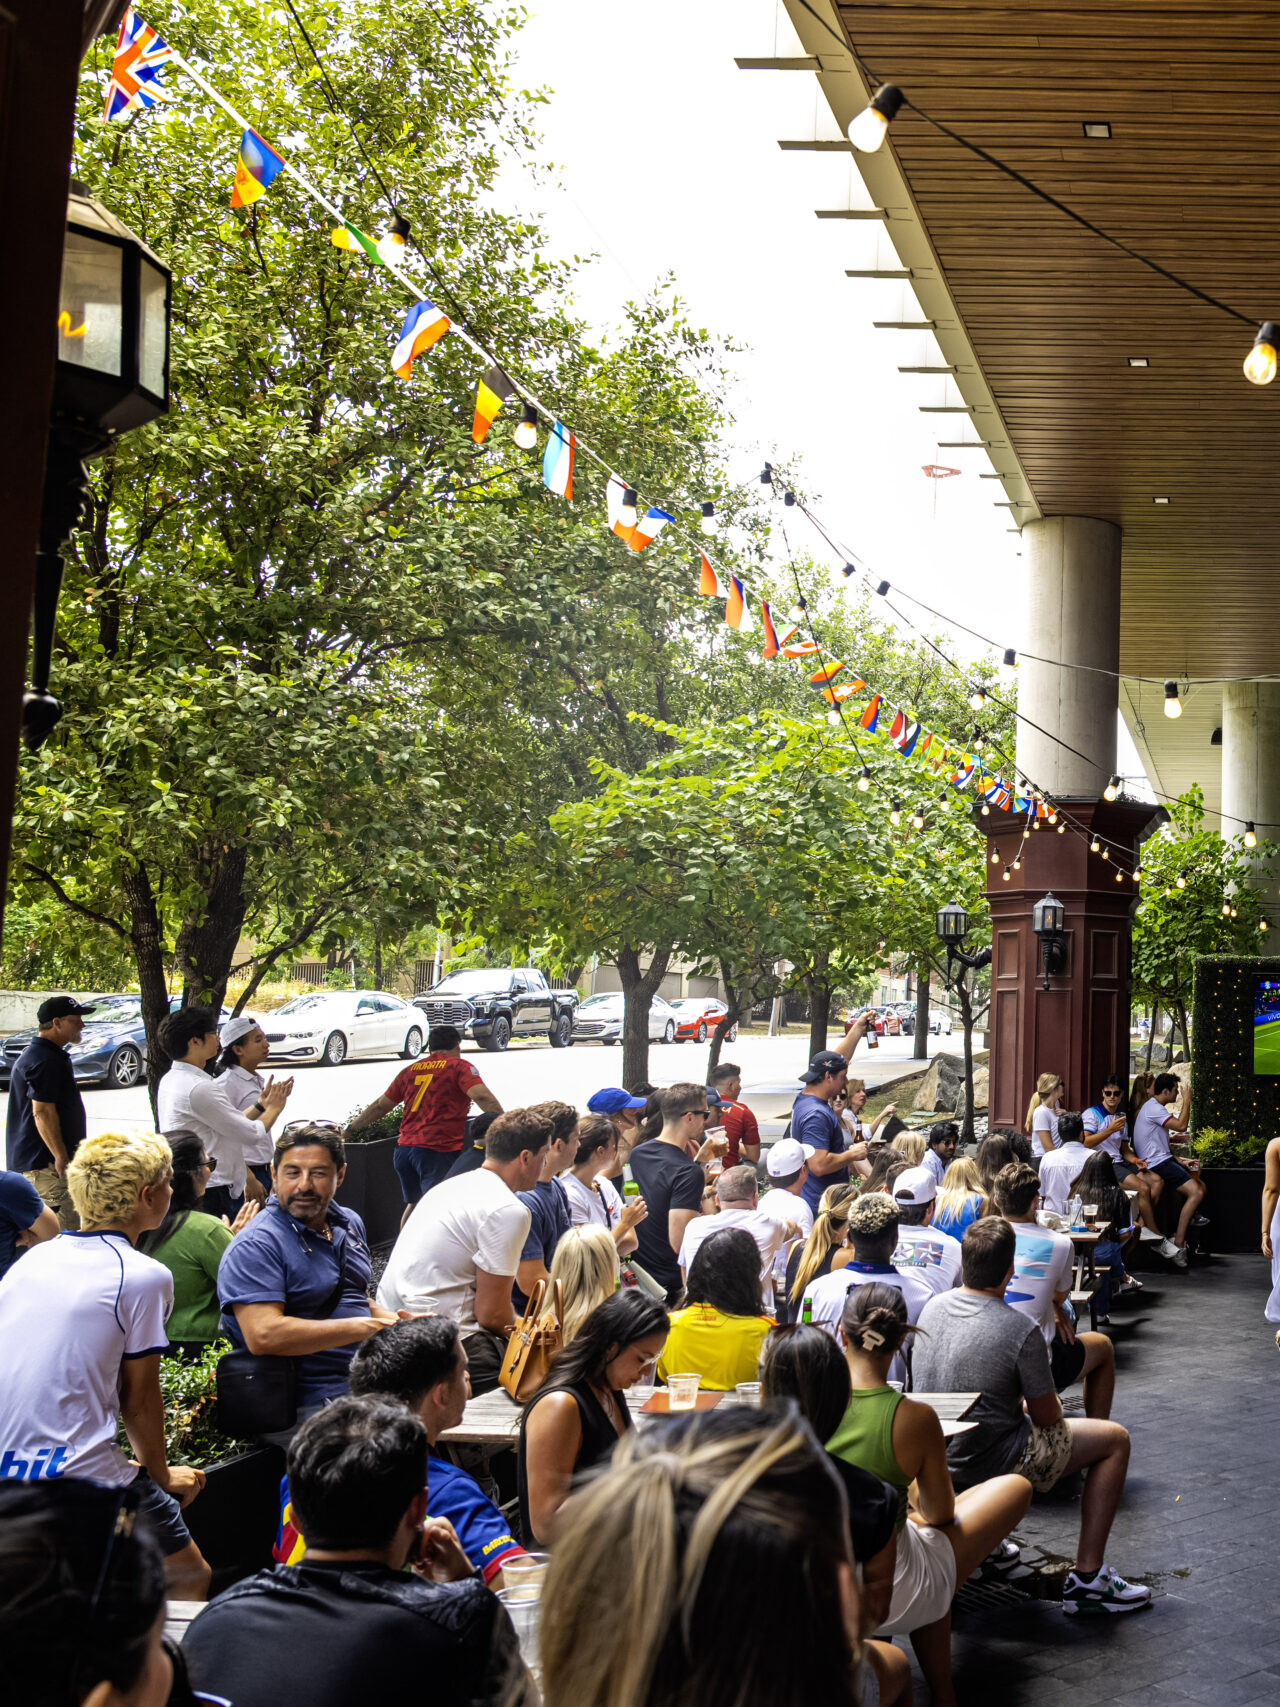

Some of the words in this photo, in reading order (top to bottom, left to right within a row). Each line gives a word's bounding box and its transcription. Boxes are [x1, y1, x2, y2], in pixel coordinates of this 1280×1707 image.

[1267, 1013, 1280, 1021] vivo
[410, 1060, 447, 1071] MORATA
[411, 1073, 434, 1112] 7
